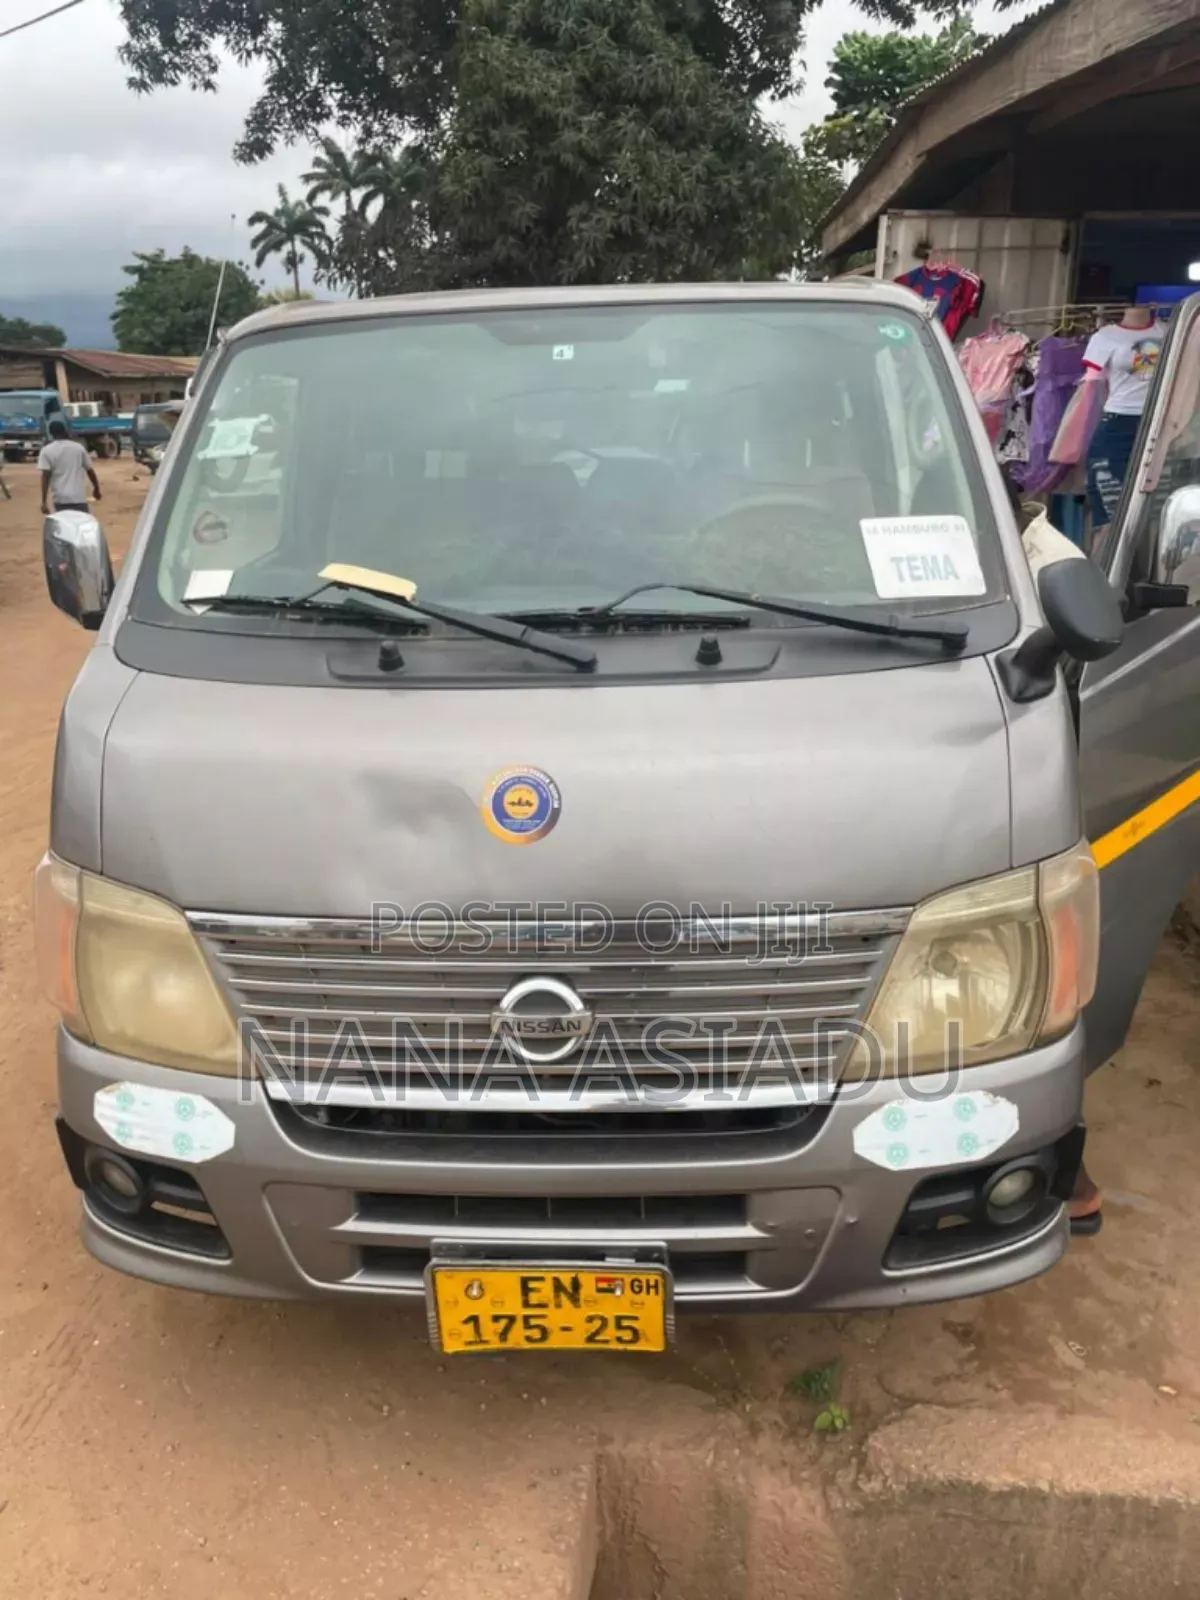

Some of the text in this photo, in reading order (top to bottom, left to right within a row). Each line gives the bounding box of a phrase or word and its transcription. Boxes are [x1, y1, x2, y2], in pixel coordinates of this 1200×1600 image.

[890, 554, 960, 582] TEMA
[501, 1020, 580, 1034] NISSAN
[520, 1275, 582, 1309] EN
[629, 1278, 660, 1296] GH
